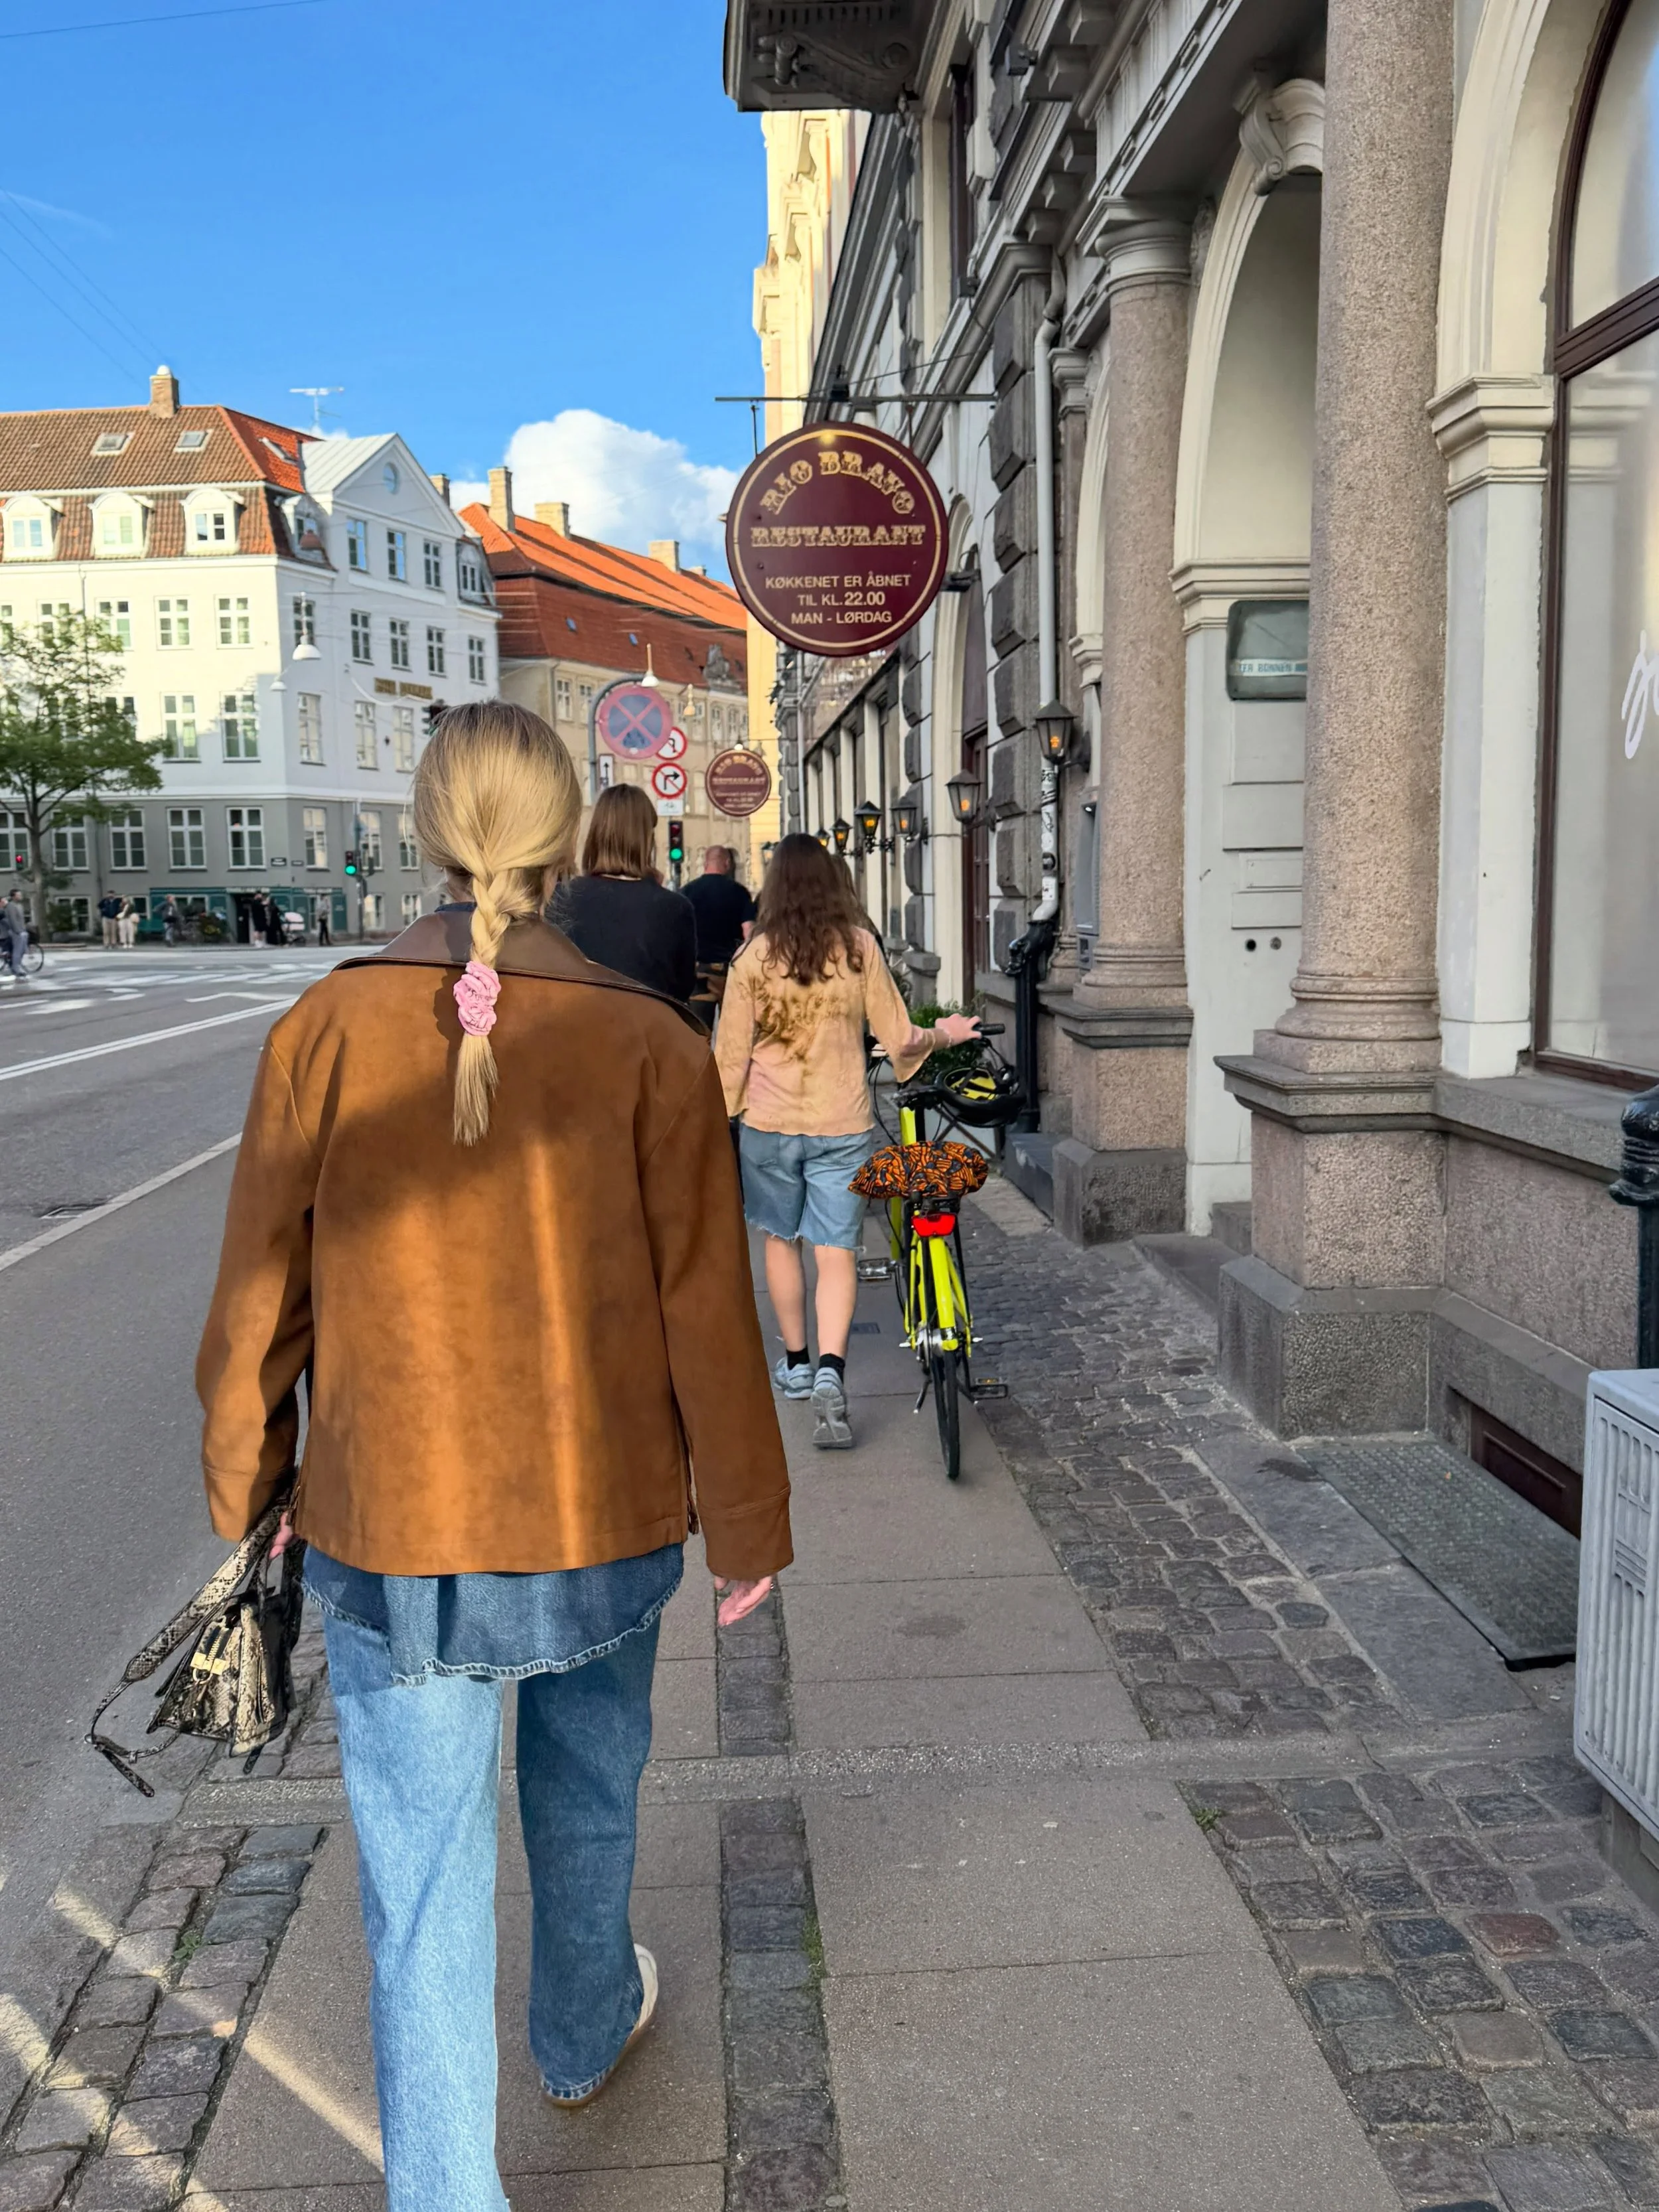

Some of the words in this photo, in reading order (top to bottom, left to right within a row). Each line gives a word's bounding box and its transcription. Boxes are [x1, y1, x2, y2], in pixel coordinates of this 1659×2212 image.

[760, 460, 813, 514] RIO
[818, 451, 915, 514] BRAVO
[751, 525, 926, 547] RESTAURANT
[765, 576, 840, 589] KØKKENET
[844, 575, 863, 587] ER
[866, 571, 912, 587] ÅBNET
[798, 594, 817, 607] TIL
[791, 612, 823, 624] MAN
[836, 611, 892, 624] LØRDAG
